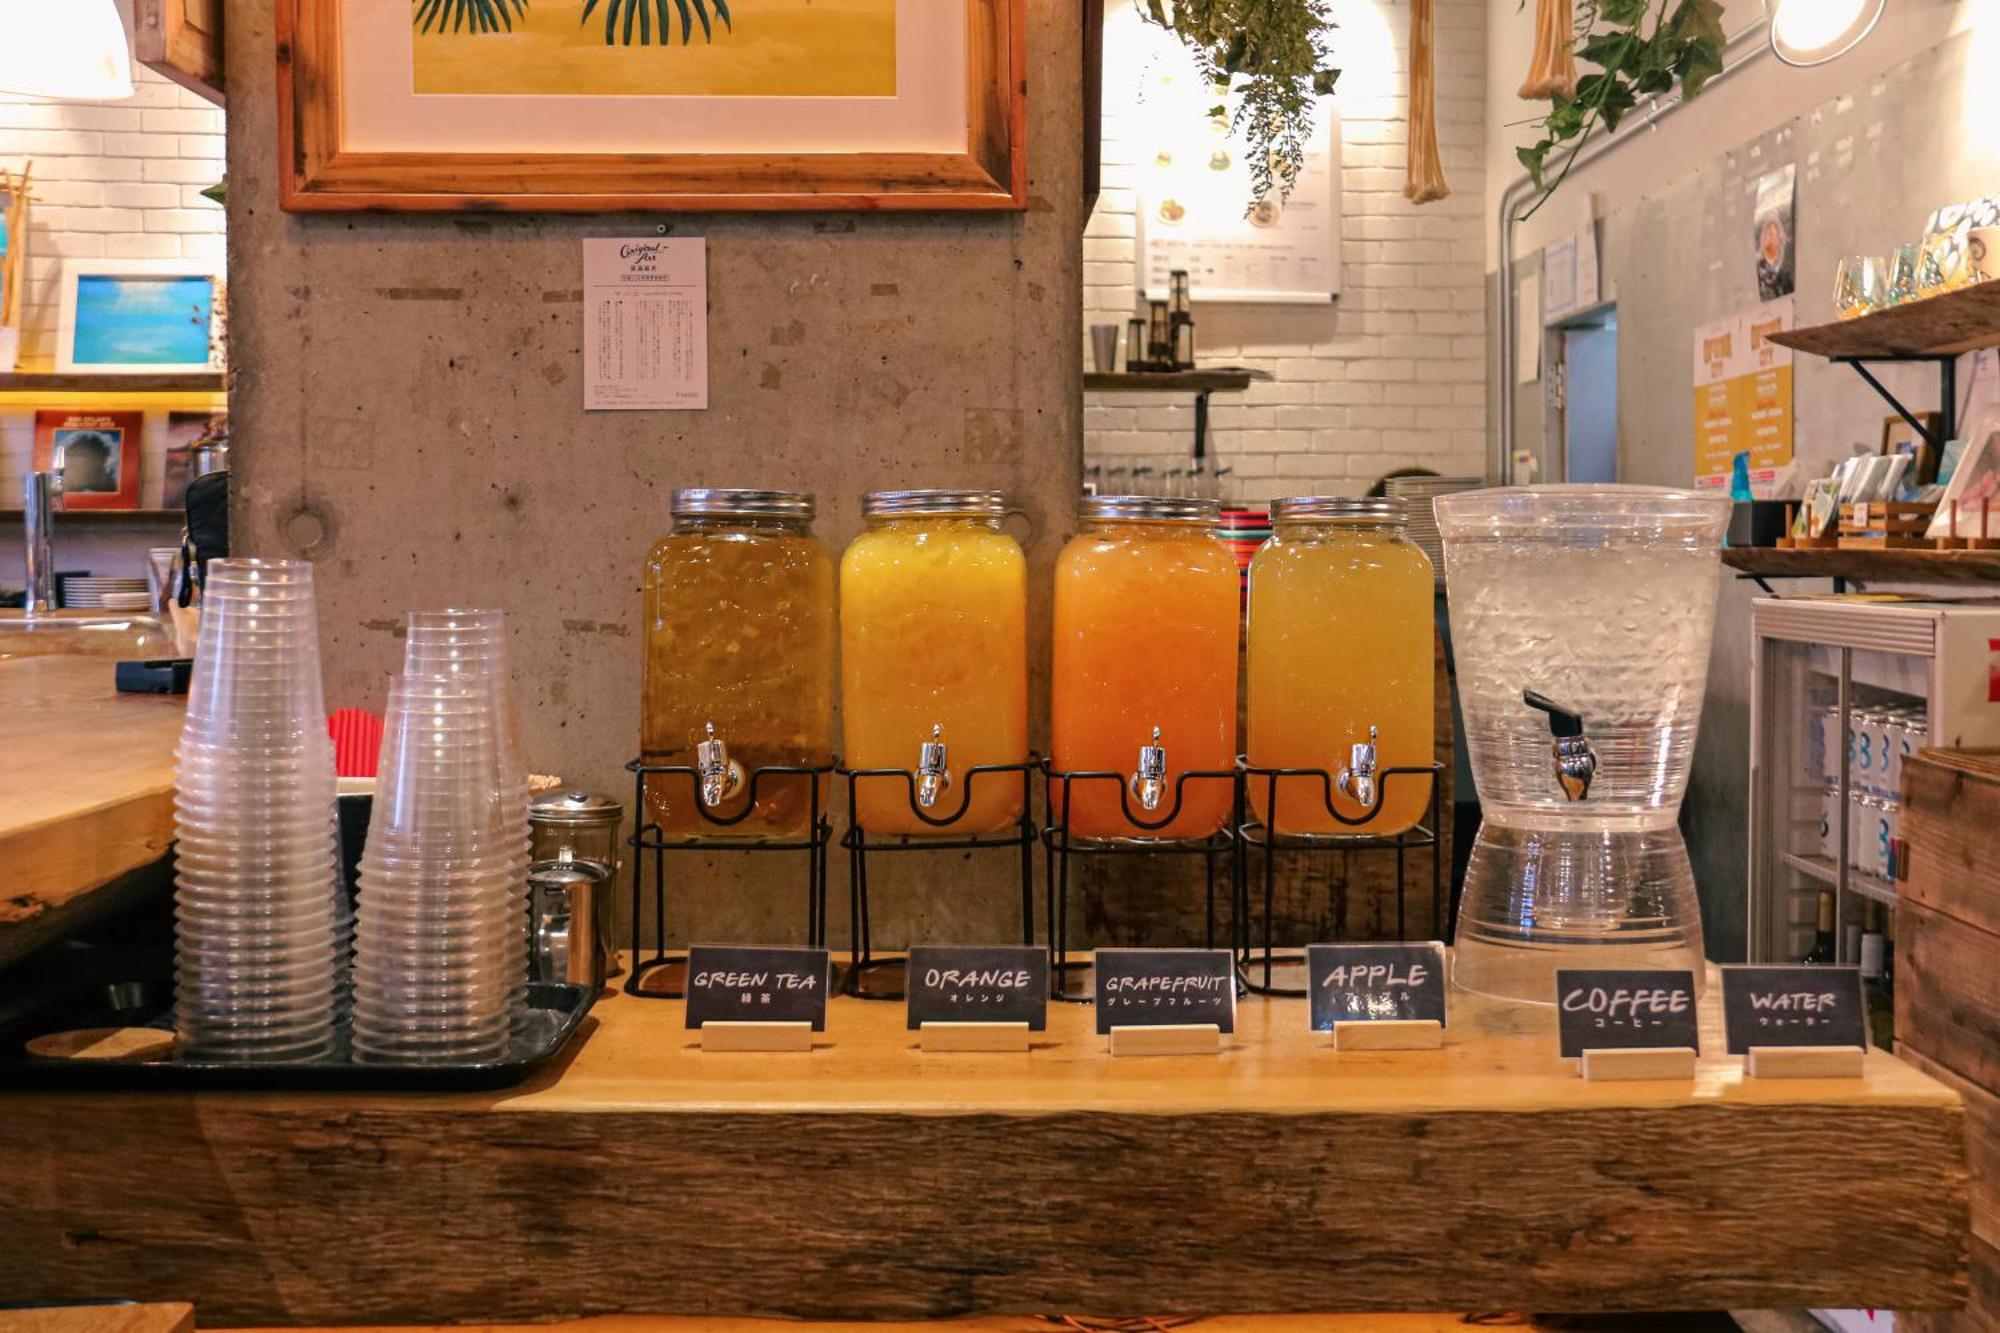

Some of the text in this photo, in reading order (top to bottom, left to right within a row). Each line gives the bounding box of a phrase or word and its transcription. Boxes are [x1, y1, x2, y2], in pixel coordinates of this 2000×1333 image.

[694, 971, 817, 990] GREEN TEA
[924, 968, 1031, 990] ORANGE
[1106, 975, 1227, 993] GRAPEFRUIT
[1322, 962, 1428, 987] APPLE
[950, 993, 1005, 1003] オレンジ
[1107, 996, 1222, 1006] グレープフルーツ
[1562, 986, 1690, 1017] COFFEE
[1749, 992, 1837, 1012] WATER
[1594, 1018, 1663, 1028] コーヒー
